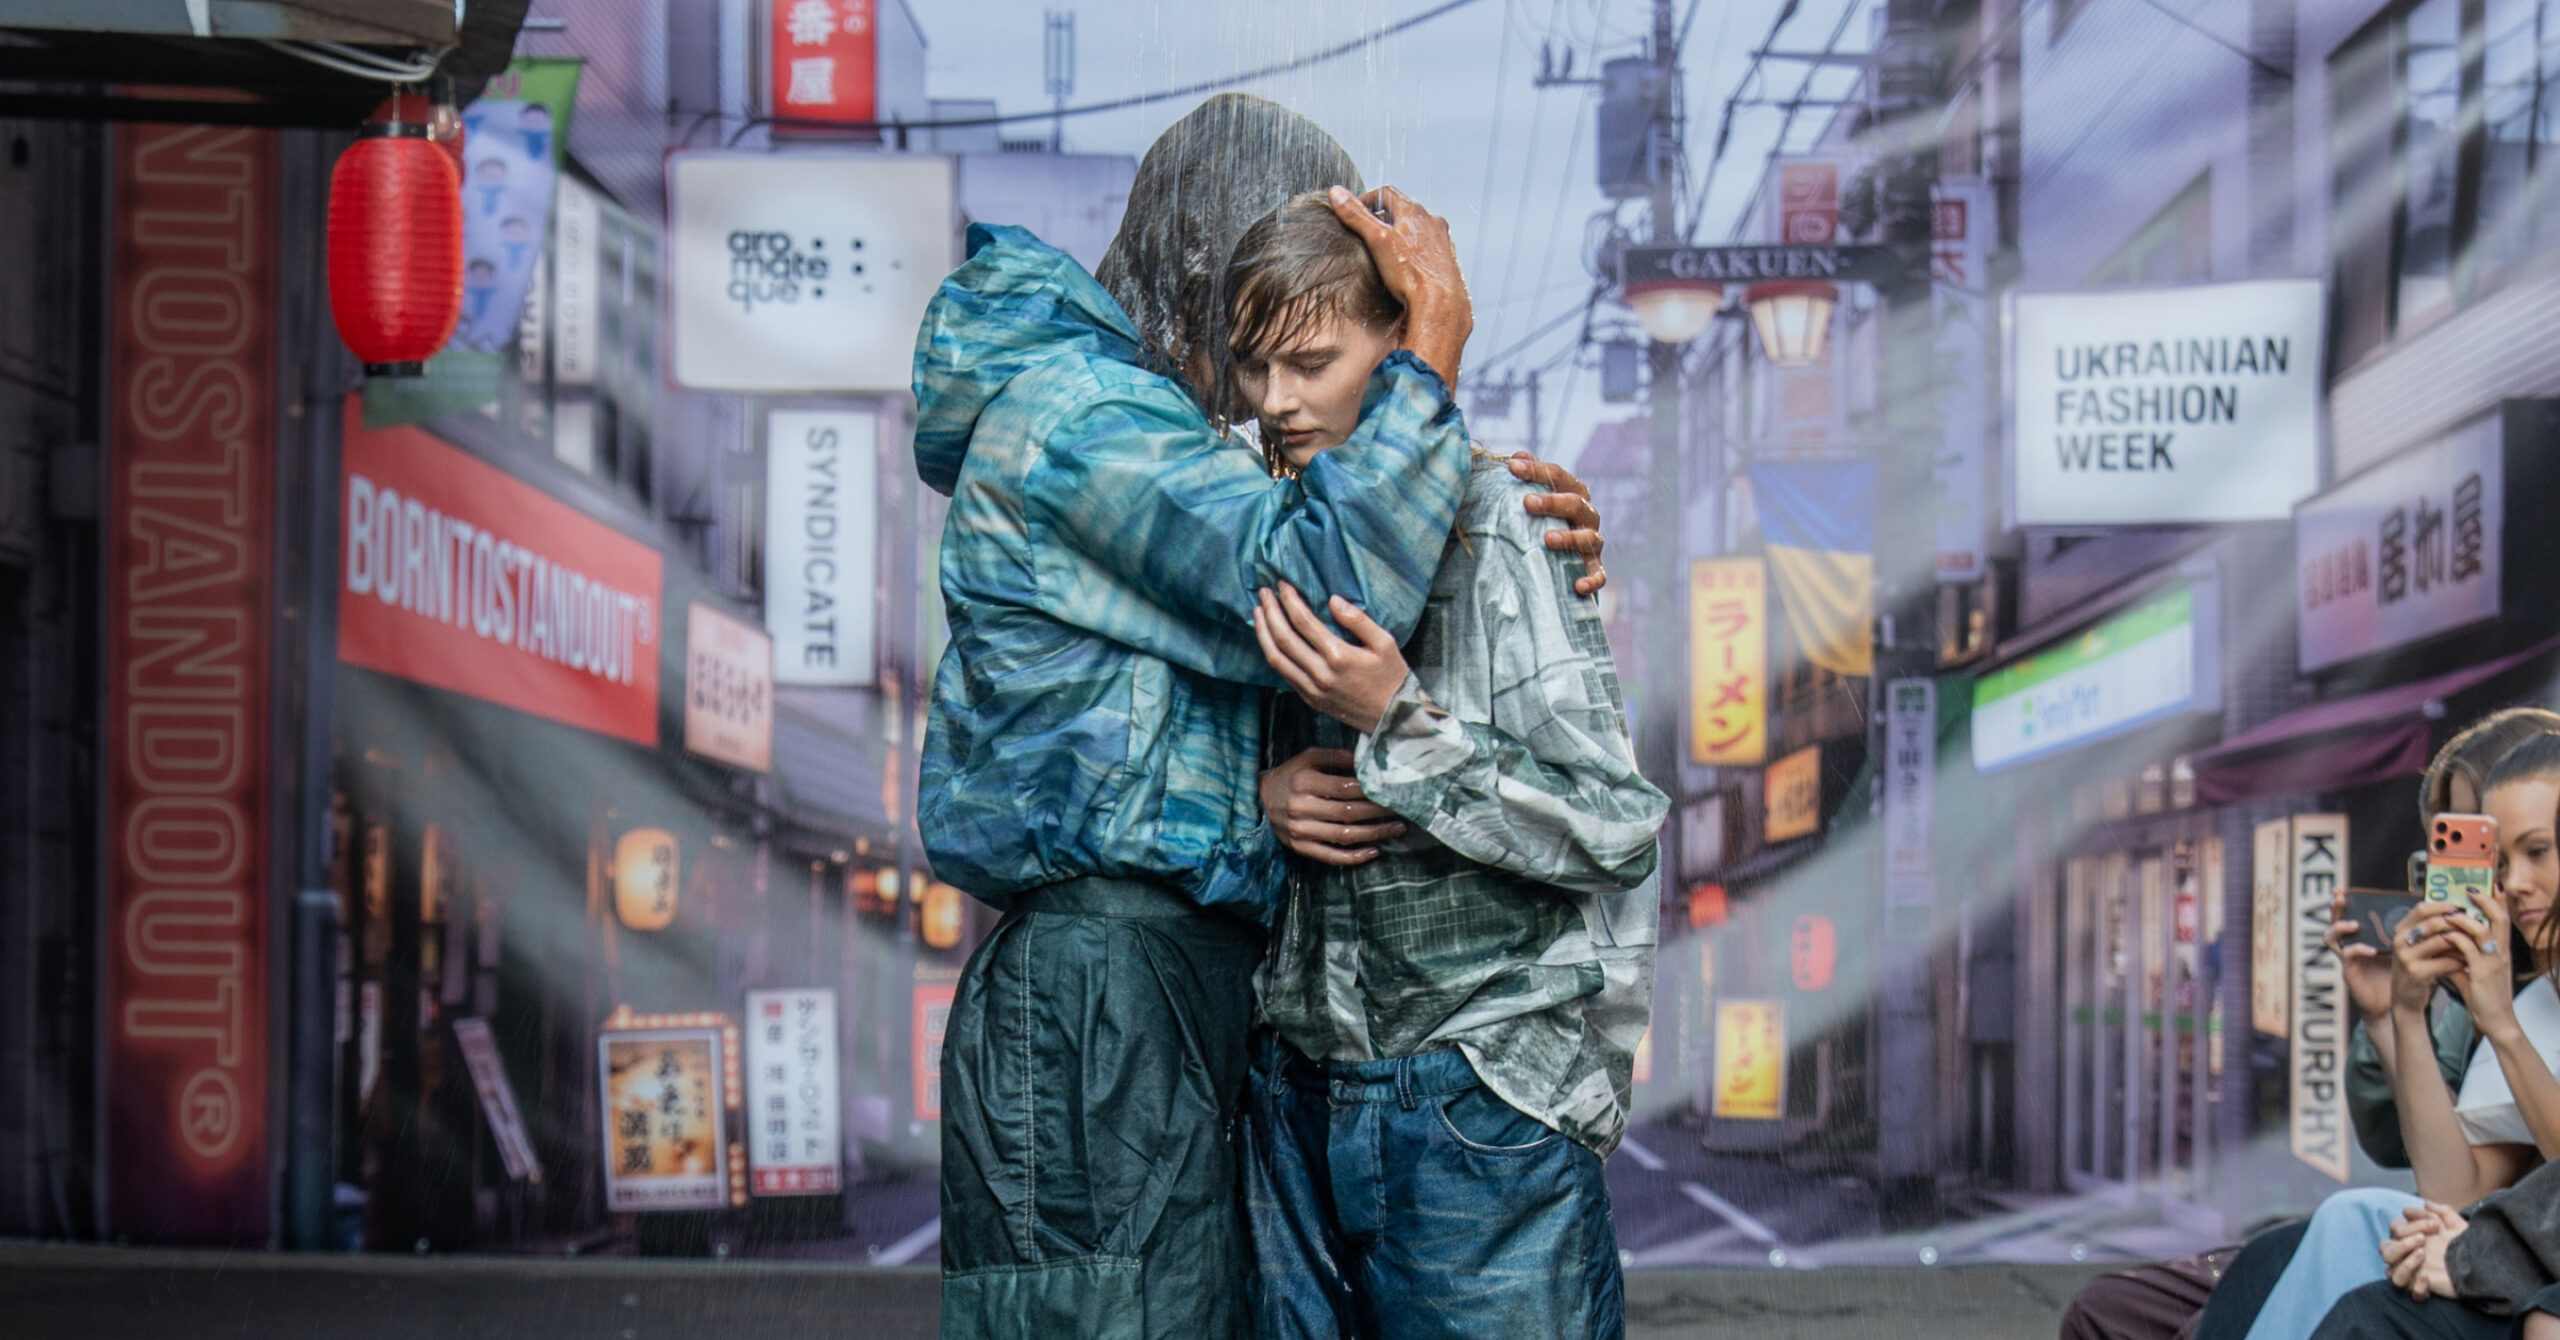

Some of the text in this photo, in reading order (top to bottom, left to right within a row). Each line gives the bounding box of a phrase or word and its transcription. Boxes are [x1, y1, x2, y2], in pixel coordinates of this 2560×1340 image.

[728, 231, 791, 255] aro
[731, 253, 829, 280] mate
[728, 280, 800, 314] que
[2056, 337, 2289, 382] UKRAINIAN
[2056, 385, 2237, 425] FASHION
[2054, 431, 2175, 472] WEEK
[803, 425, 840, 669] SYNDICATE
[1708, 600, 1753, 753] ラーメン
